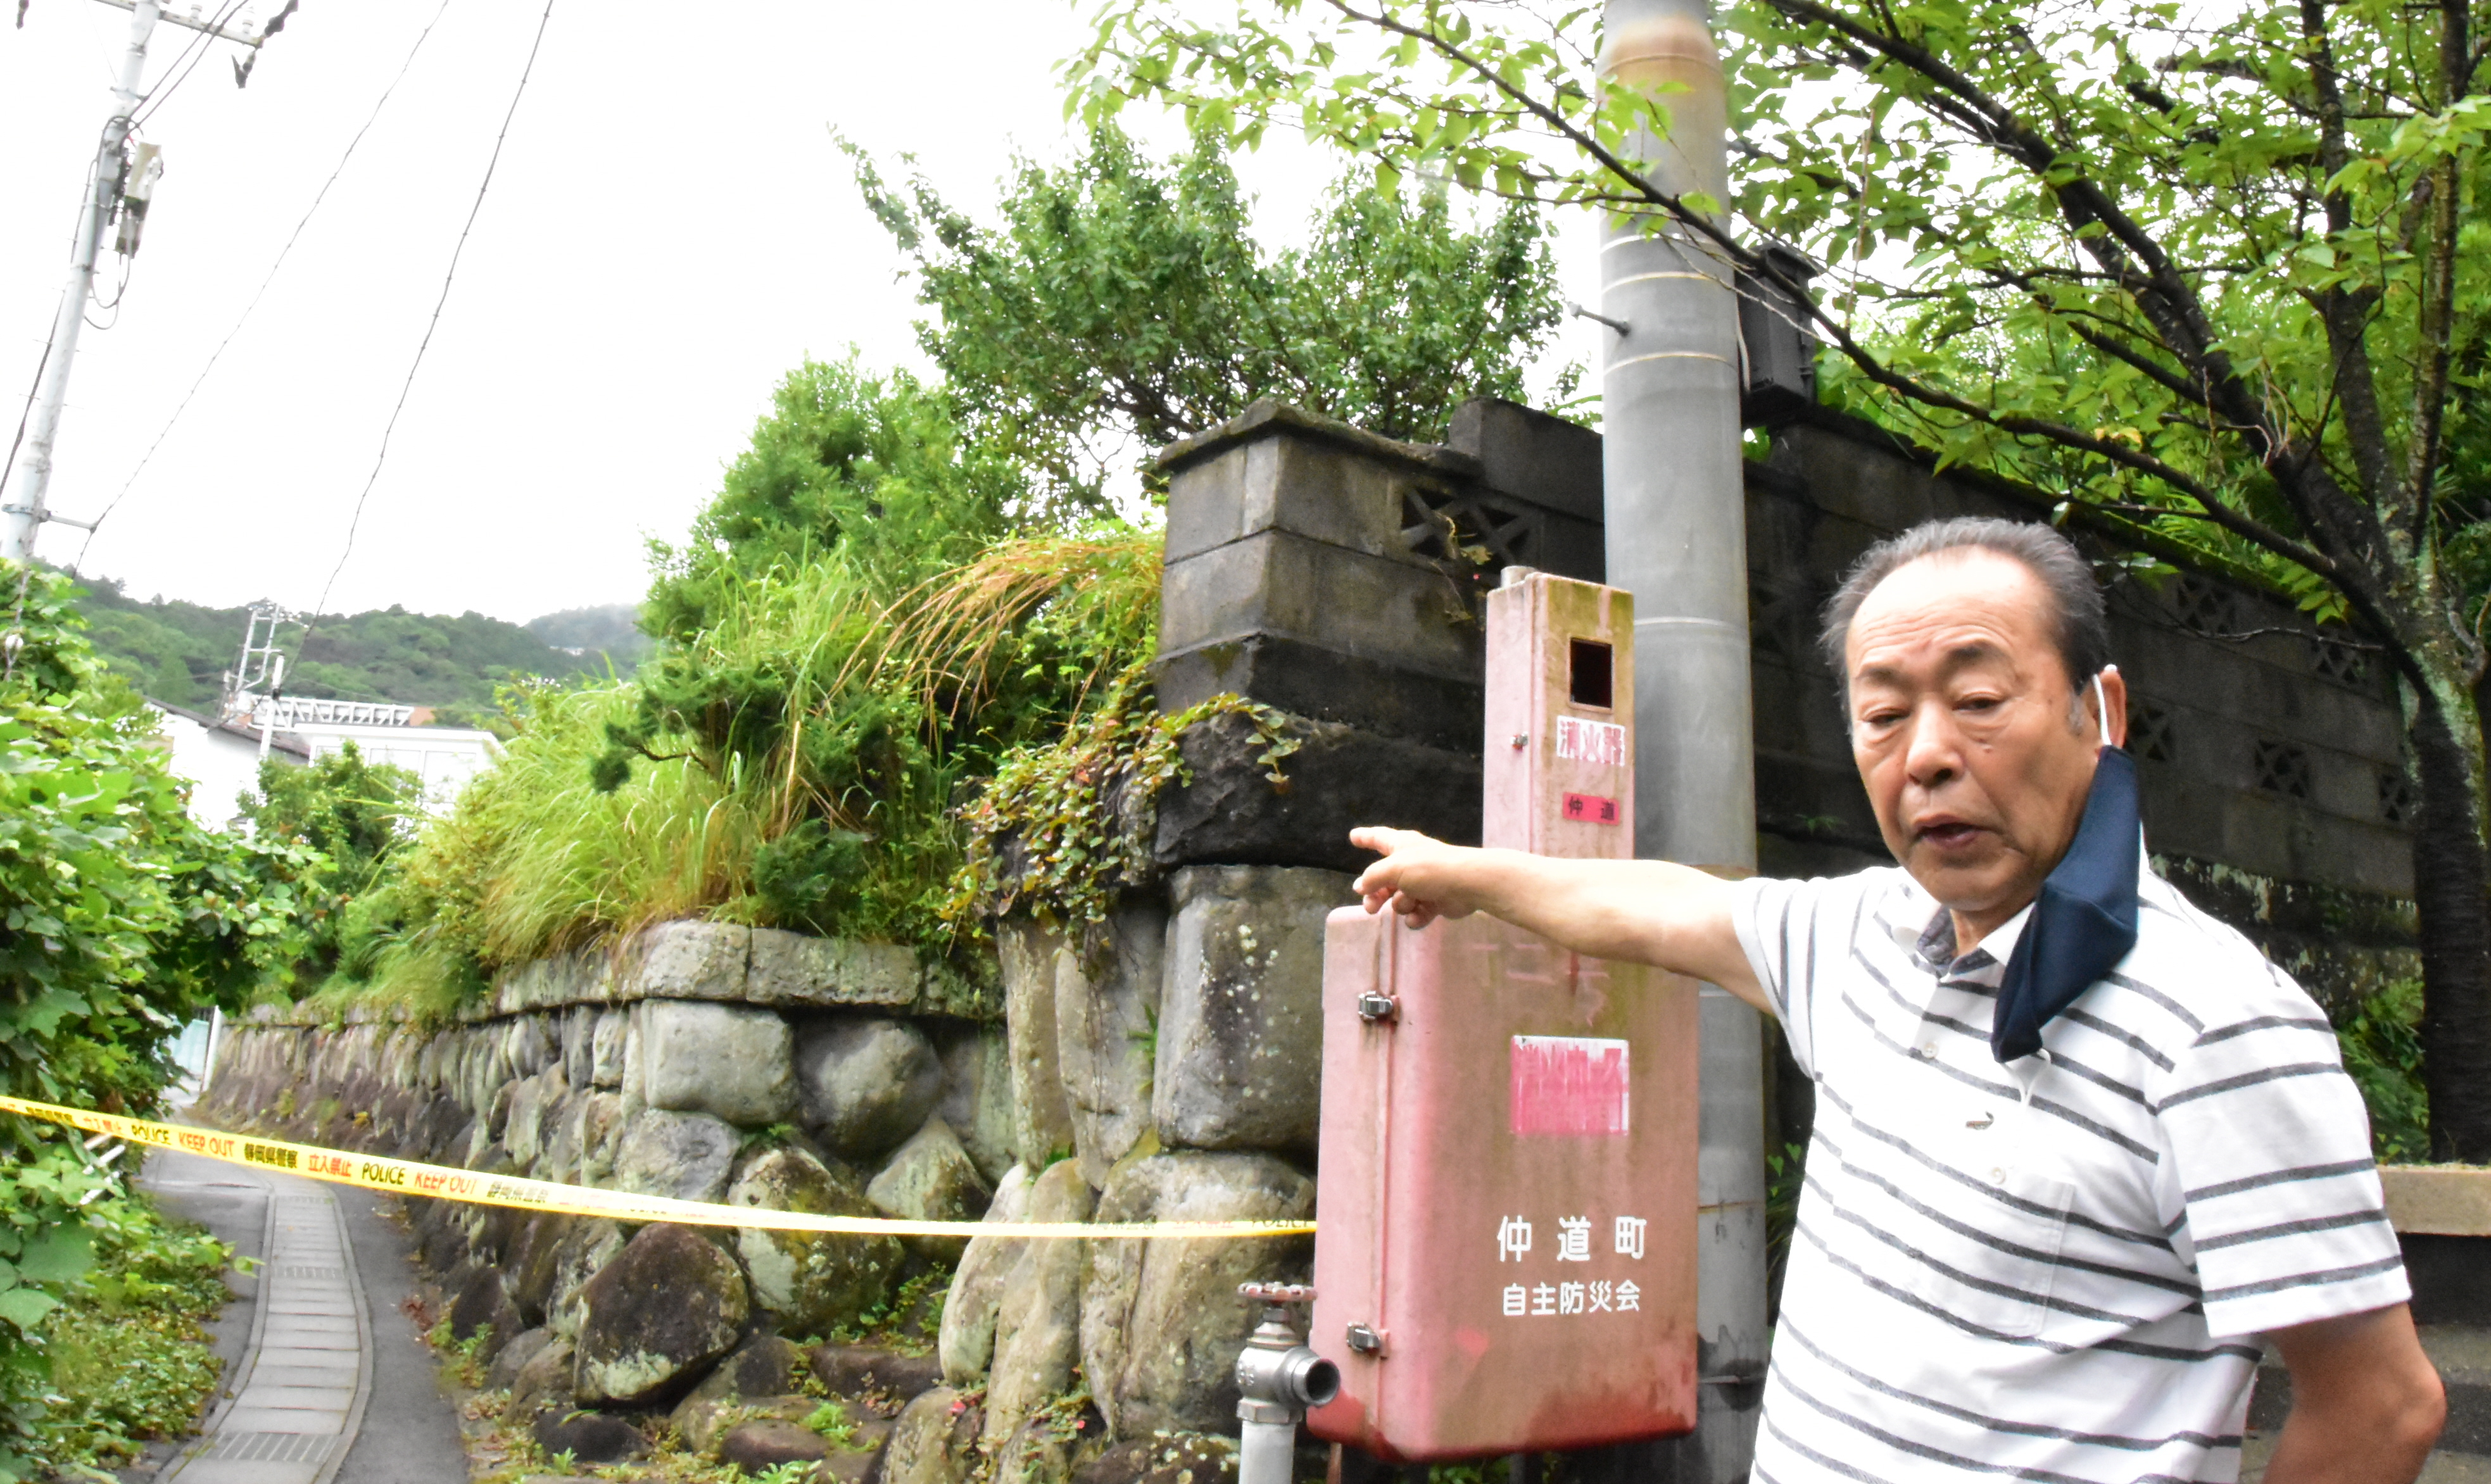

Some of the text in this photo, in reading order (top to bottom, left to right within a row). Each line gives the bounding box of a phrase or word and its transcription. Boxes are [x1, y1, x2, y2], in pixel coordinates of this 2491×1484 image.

[1560, 720, 1623, 764] 消火器
[131, 1124, 170, 1145] POLICE
[179, 1131, 205, 1151] KEEP
[209, 1137, 235, 1157] OUT
[308, 1154, 351, 1177] 立入禁止
[362, 1162, 406, 1185] POLICE
[415, 1171, 447, 1191] KEEP
[450, 1175, 479, 1195] OUT
[1496, 1214, 1647, 1262] 仲道町
[1503, 1279, 1641, 1316] 自主防災会
